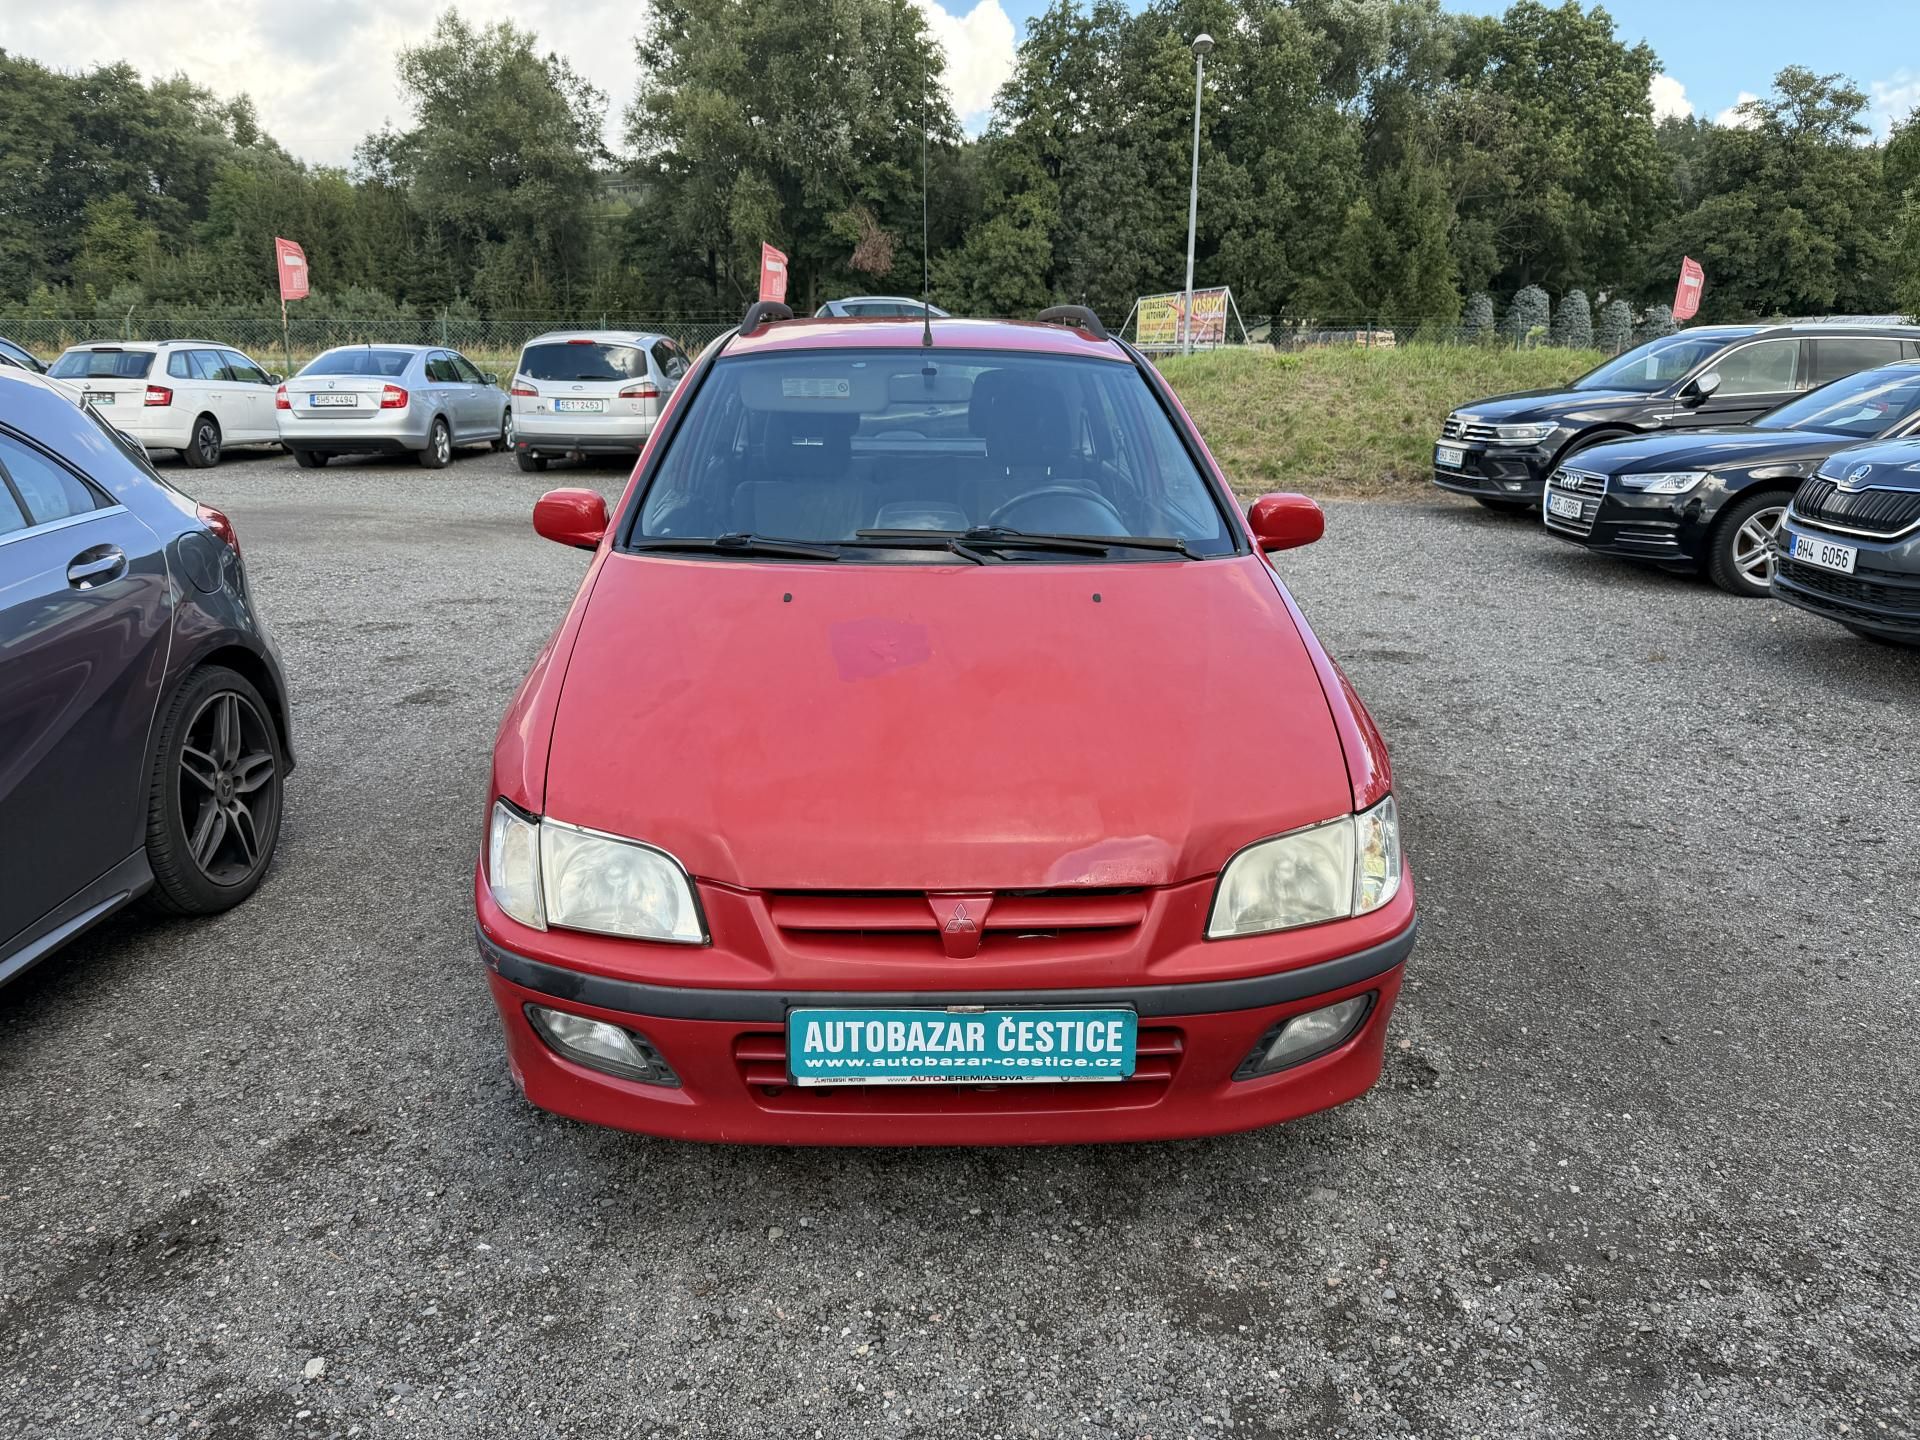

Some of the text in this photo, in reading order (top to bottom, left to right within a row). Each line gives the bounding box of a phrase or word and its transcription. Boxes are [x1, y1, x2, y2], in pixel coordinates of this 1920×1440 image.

[1181, 296, 1225, 314] KVOŠROT
[561, 401, 600, 409] 5E1 2453
[1797, 540, 1849, 568] 8H4 6056
[804, 1016, 1123, 1053] AUTOBAZAR ČESTICE
[805, 1055, 1122, 1068] www.autobazar-cestice.cz
